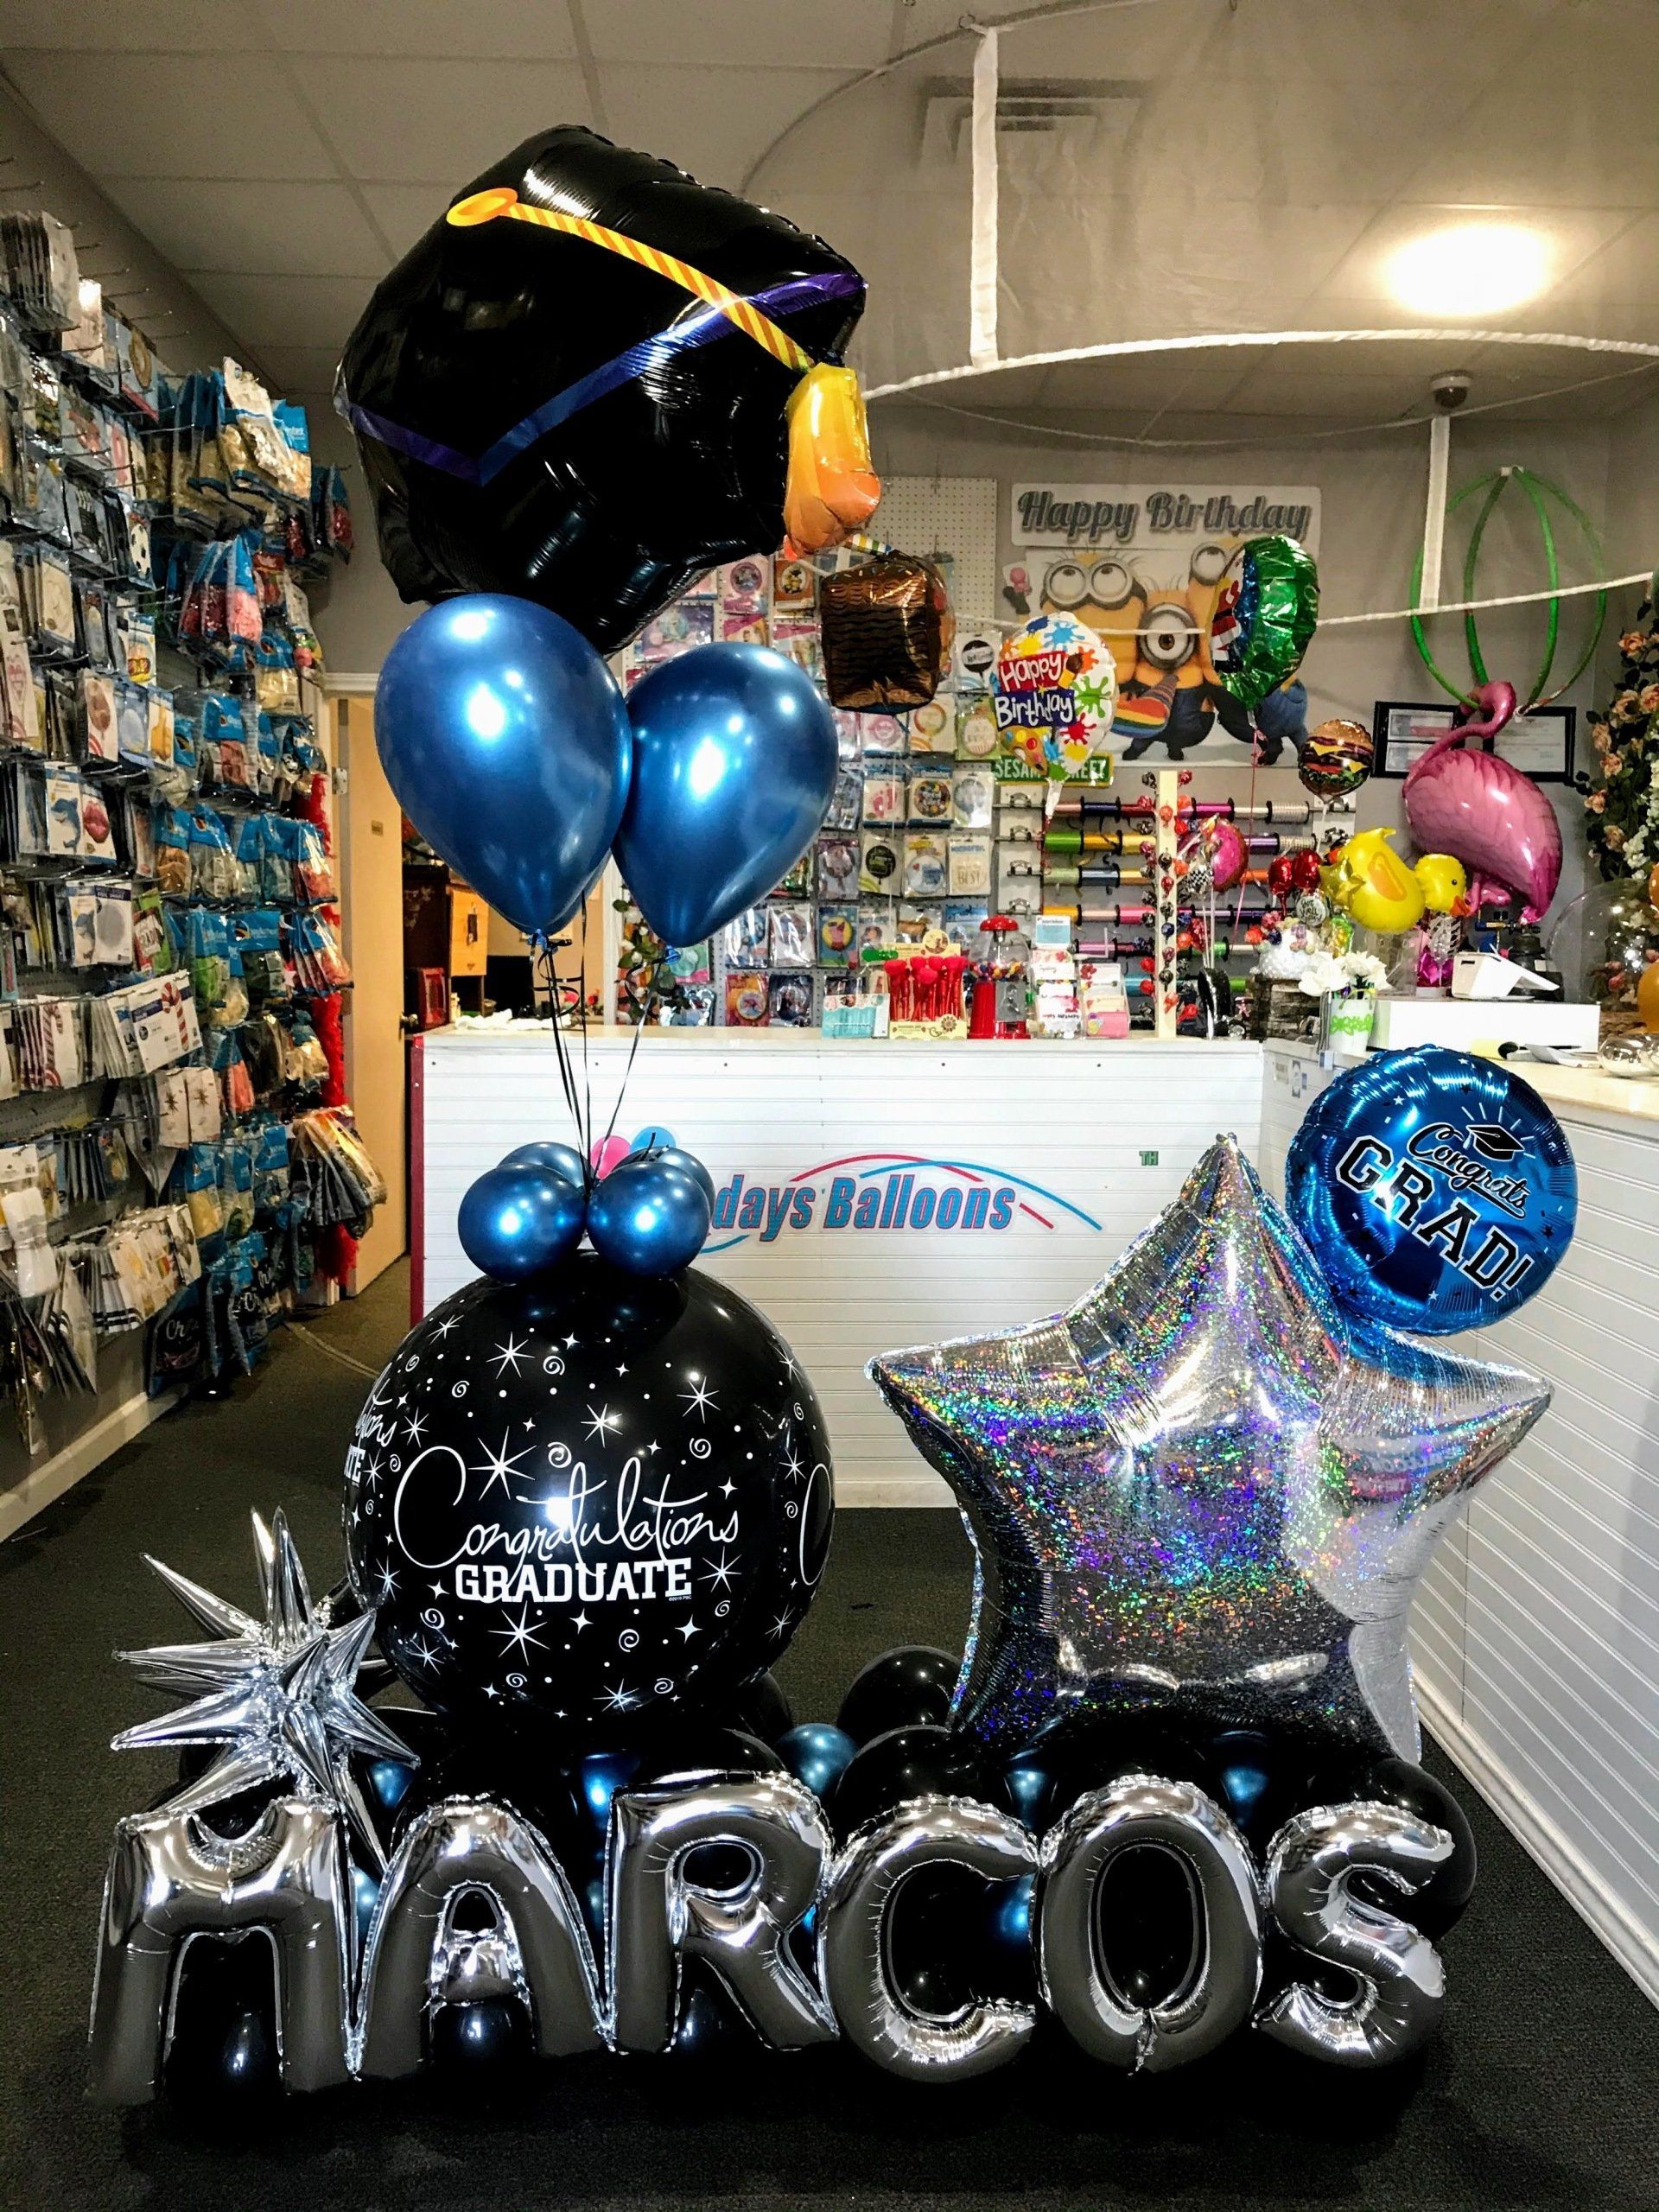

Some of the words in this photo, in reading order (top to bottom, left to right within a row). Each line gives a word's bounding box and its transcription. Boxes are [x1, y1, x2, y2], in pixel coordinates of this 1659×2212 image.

[1017, 490, 1140, 543] Happy
[1146, 491, 1312, 543] Birthday
[1000, 653, 1062, 692] Happy
[995, 690, 1073, 728] Birthday
[1406, 1122, 1530, 1217] Congrats
[823, 1173, 1016, 1230] Balloons
[1336, 1134, 1536, 1303] GRAD!
[393, 1445, 741, 1595] Congratulations
[454, 1557, 692, 1603] GRADUATE
[85, 1768, 1455, 2110] MARCOS
